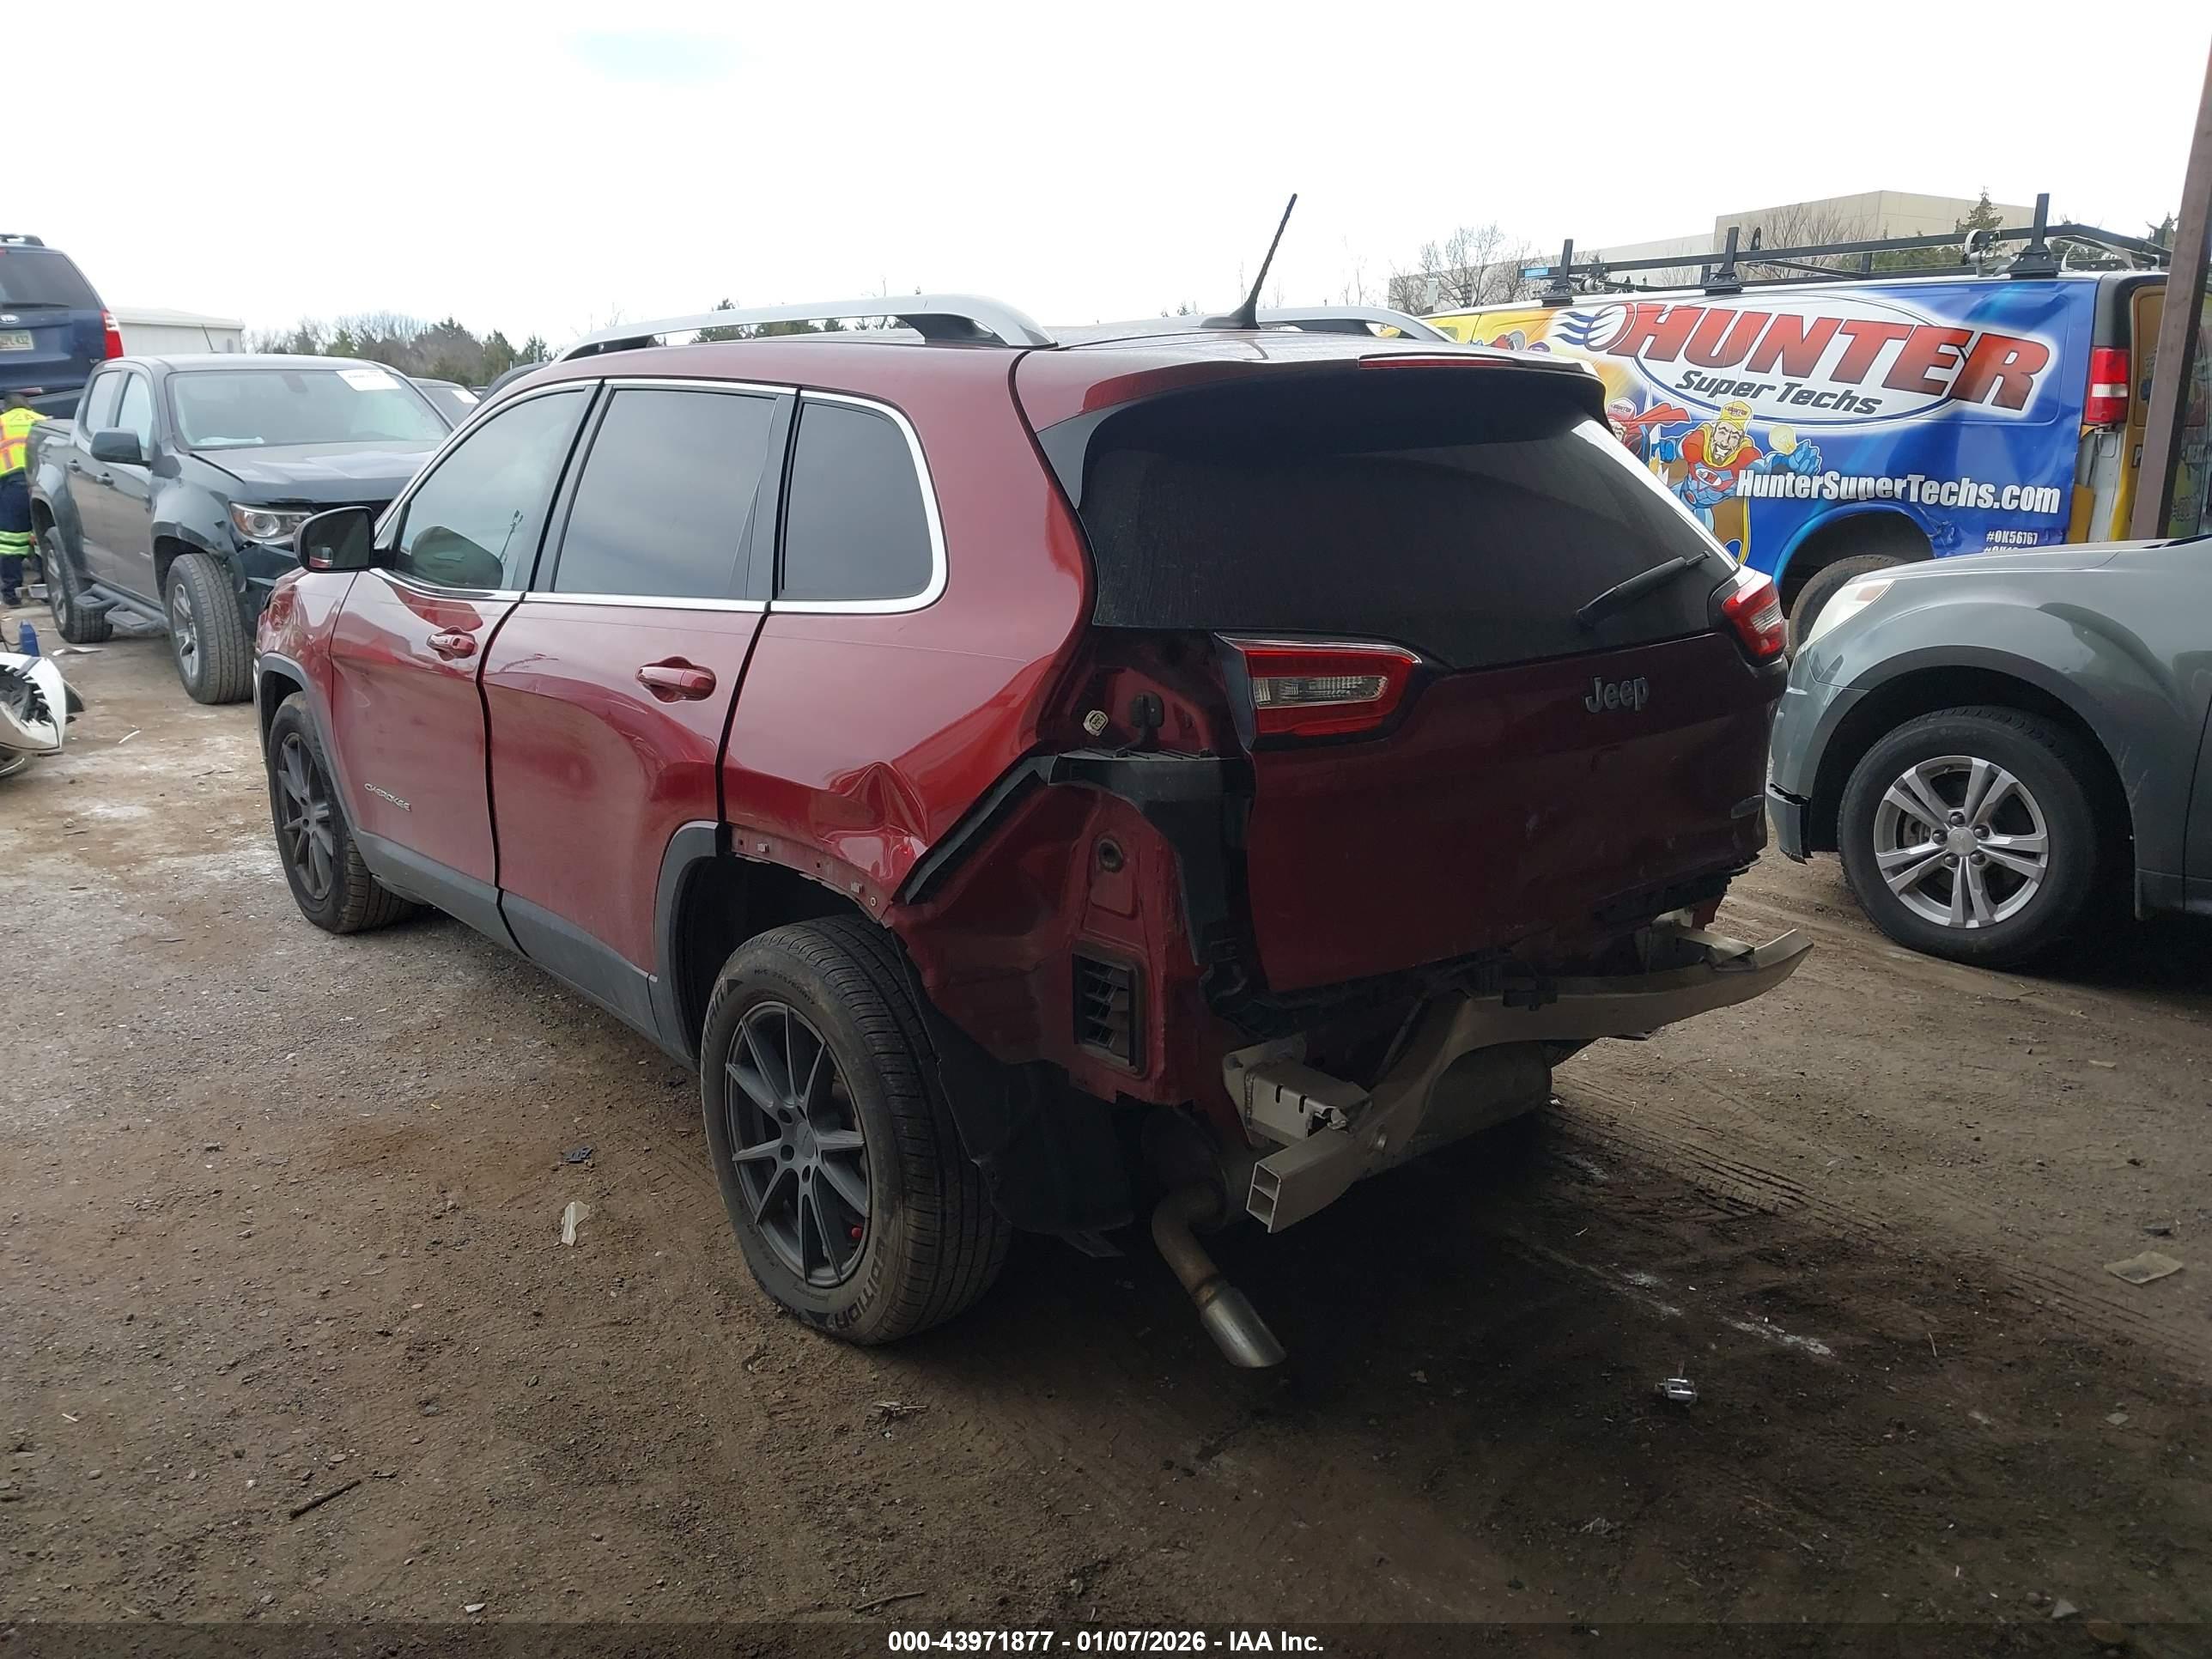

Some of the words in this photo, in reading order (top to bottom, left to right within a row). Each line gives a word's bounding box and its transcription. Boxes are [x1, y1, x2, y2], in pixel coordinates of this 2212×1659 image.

[1606, 301, 2051, 411] HUNTER
[1675, 370, 1777, 400] Super
[1777, 382, 1883, 416] Techs
[1735, 471, 2061, 514] HunterSuperTechs.com
[1585, 677, 1649, 714] Jeep
